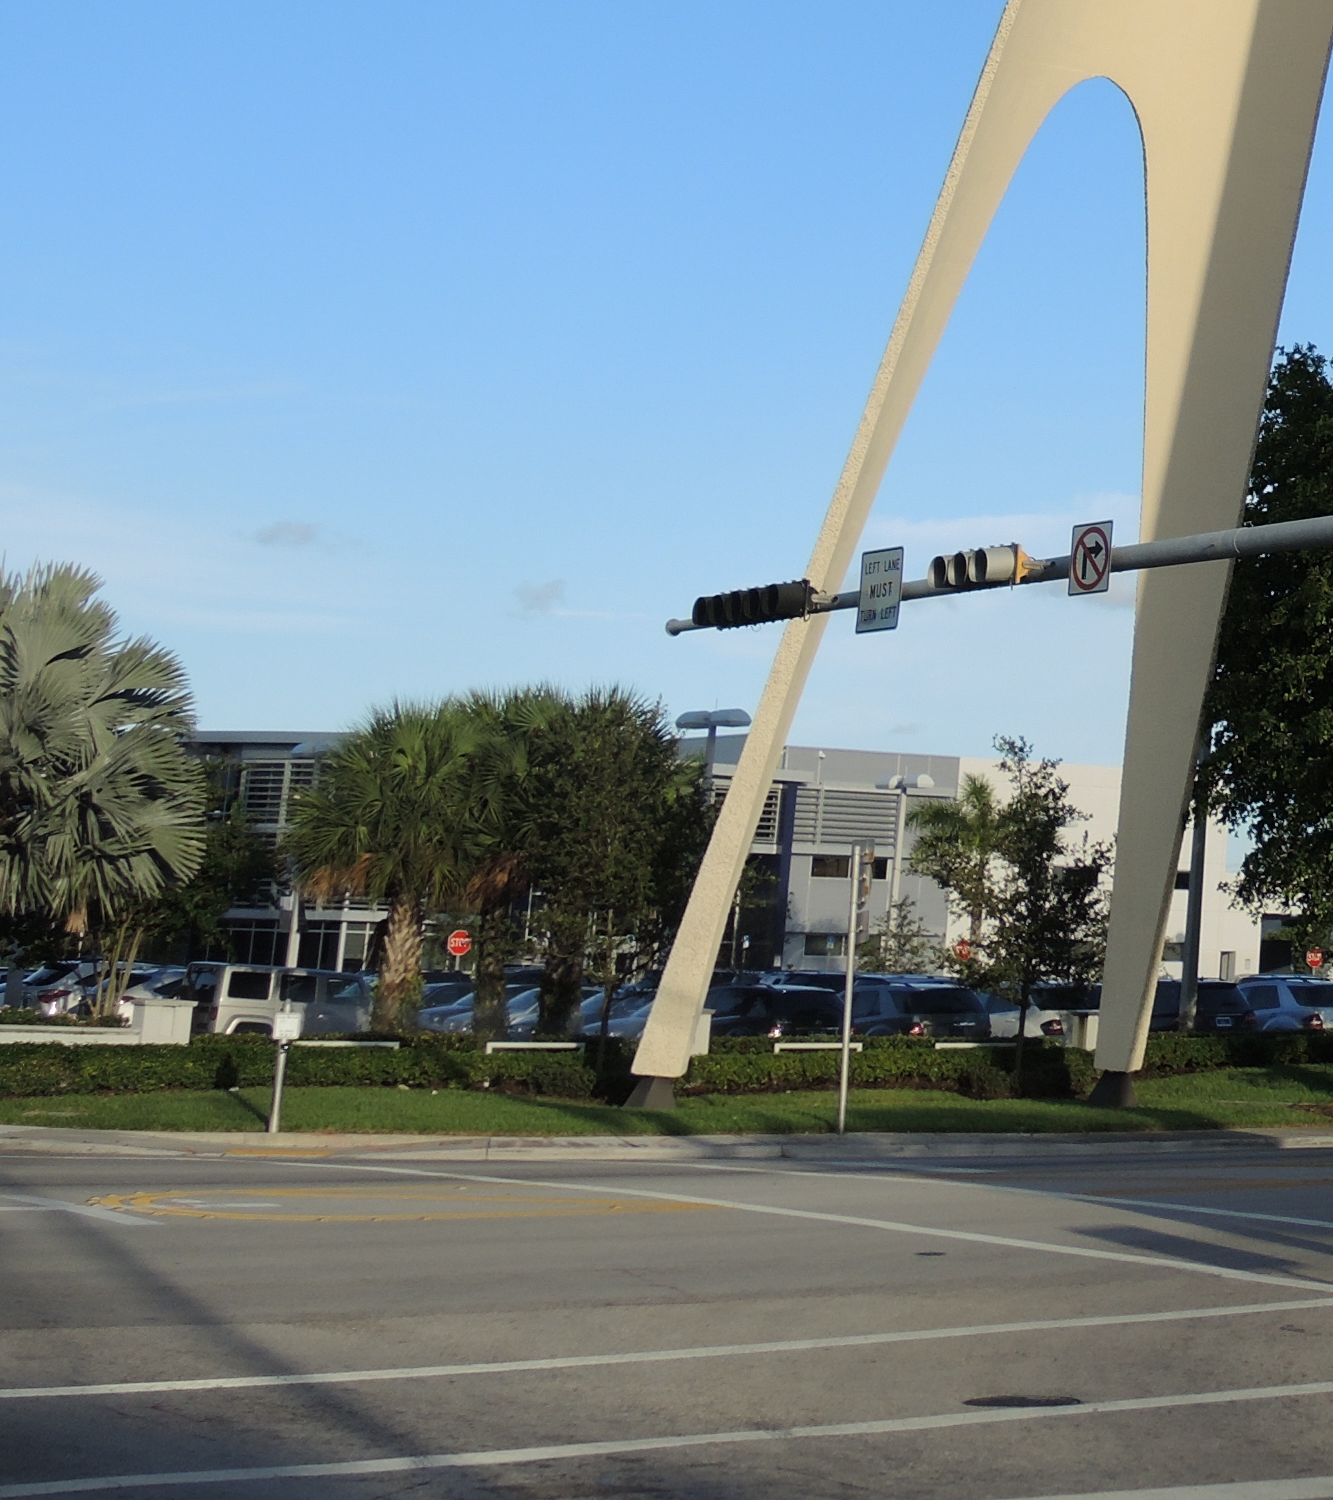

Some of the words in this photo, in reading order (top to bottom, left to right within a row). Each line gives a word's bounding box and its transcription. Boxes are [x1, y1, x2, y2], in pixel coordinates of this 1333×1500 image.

[865, 561, 880, 575] LEFT
[884, 558, 900, 572] LANE
[869, 581, 893, 599] MUST
[861, 609, 876, 622] TURN
[881, 605, 896, 620] LEFT
